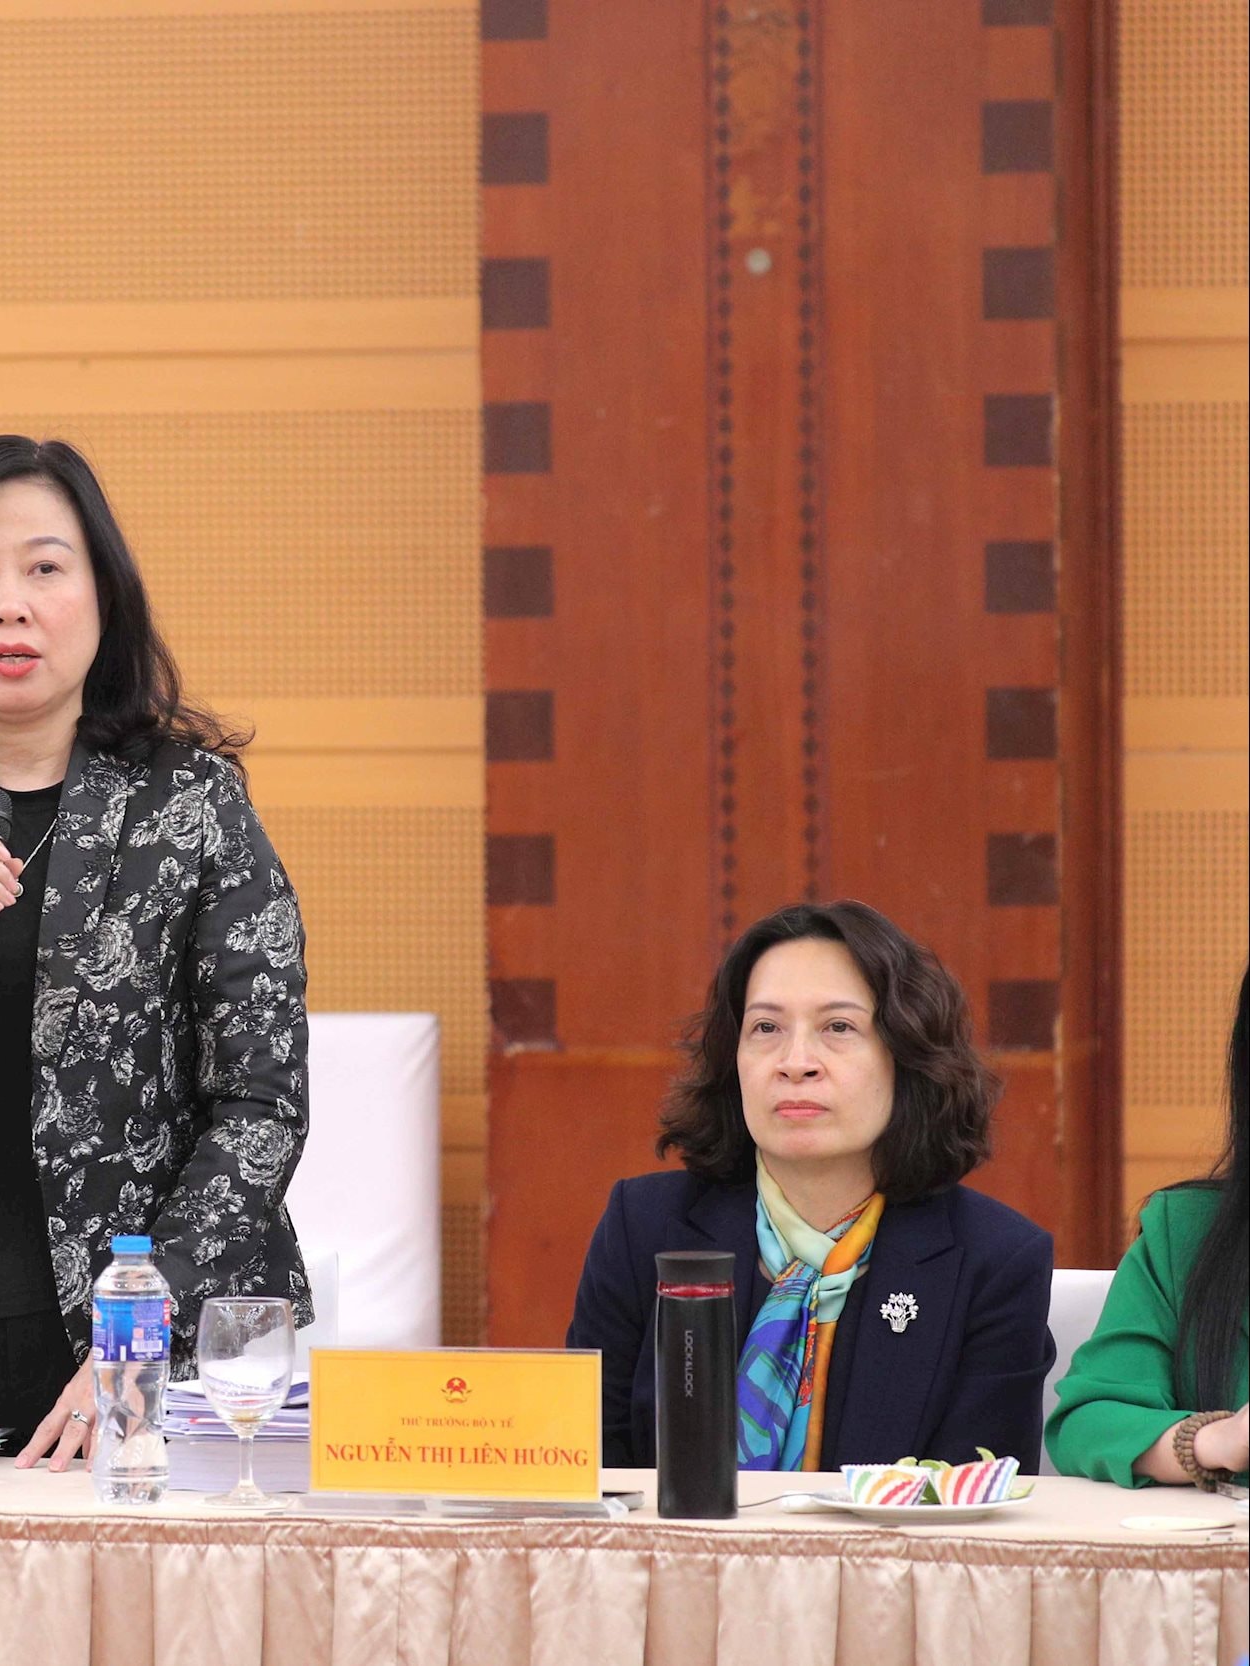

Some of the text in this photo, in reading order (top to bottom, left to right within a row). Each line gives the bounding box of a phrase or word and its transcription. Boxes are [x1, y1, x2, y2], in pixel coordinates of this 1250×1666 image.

[685, 1329, 693, 1398] LOCK&LOCK
[326, 1437, 587, 1467] NGUYỄN THỊ LIÊN HƯƠNG
